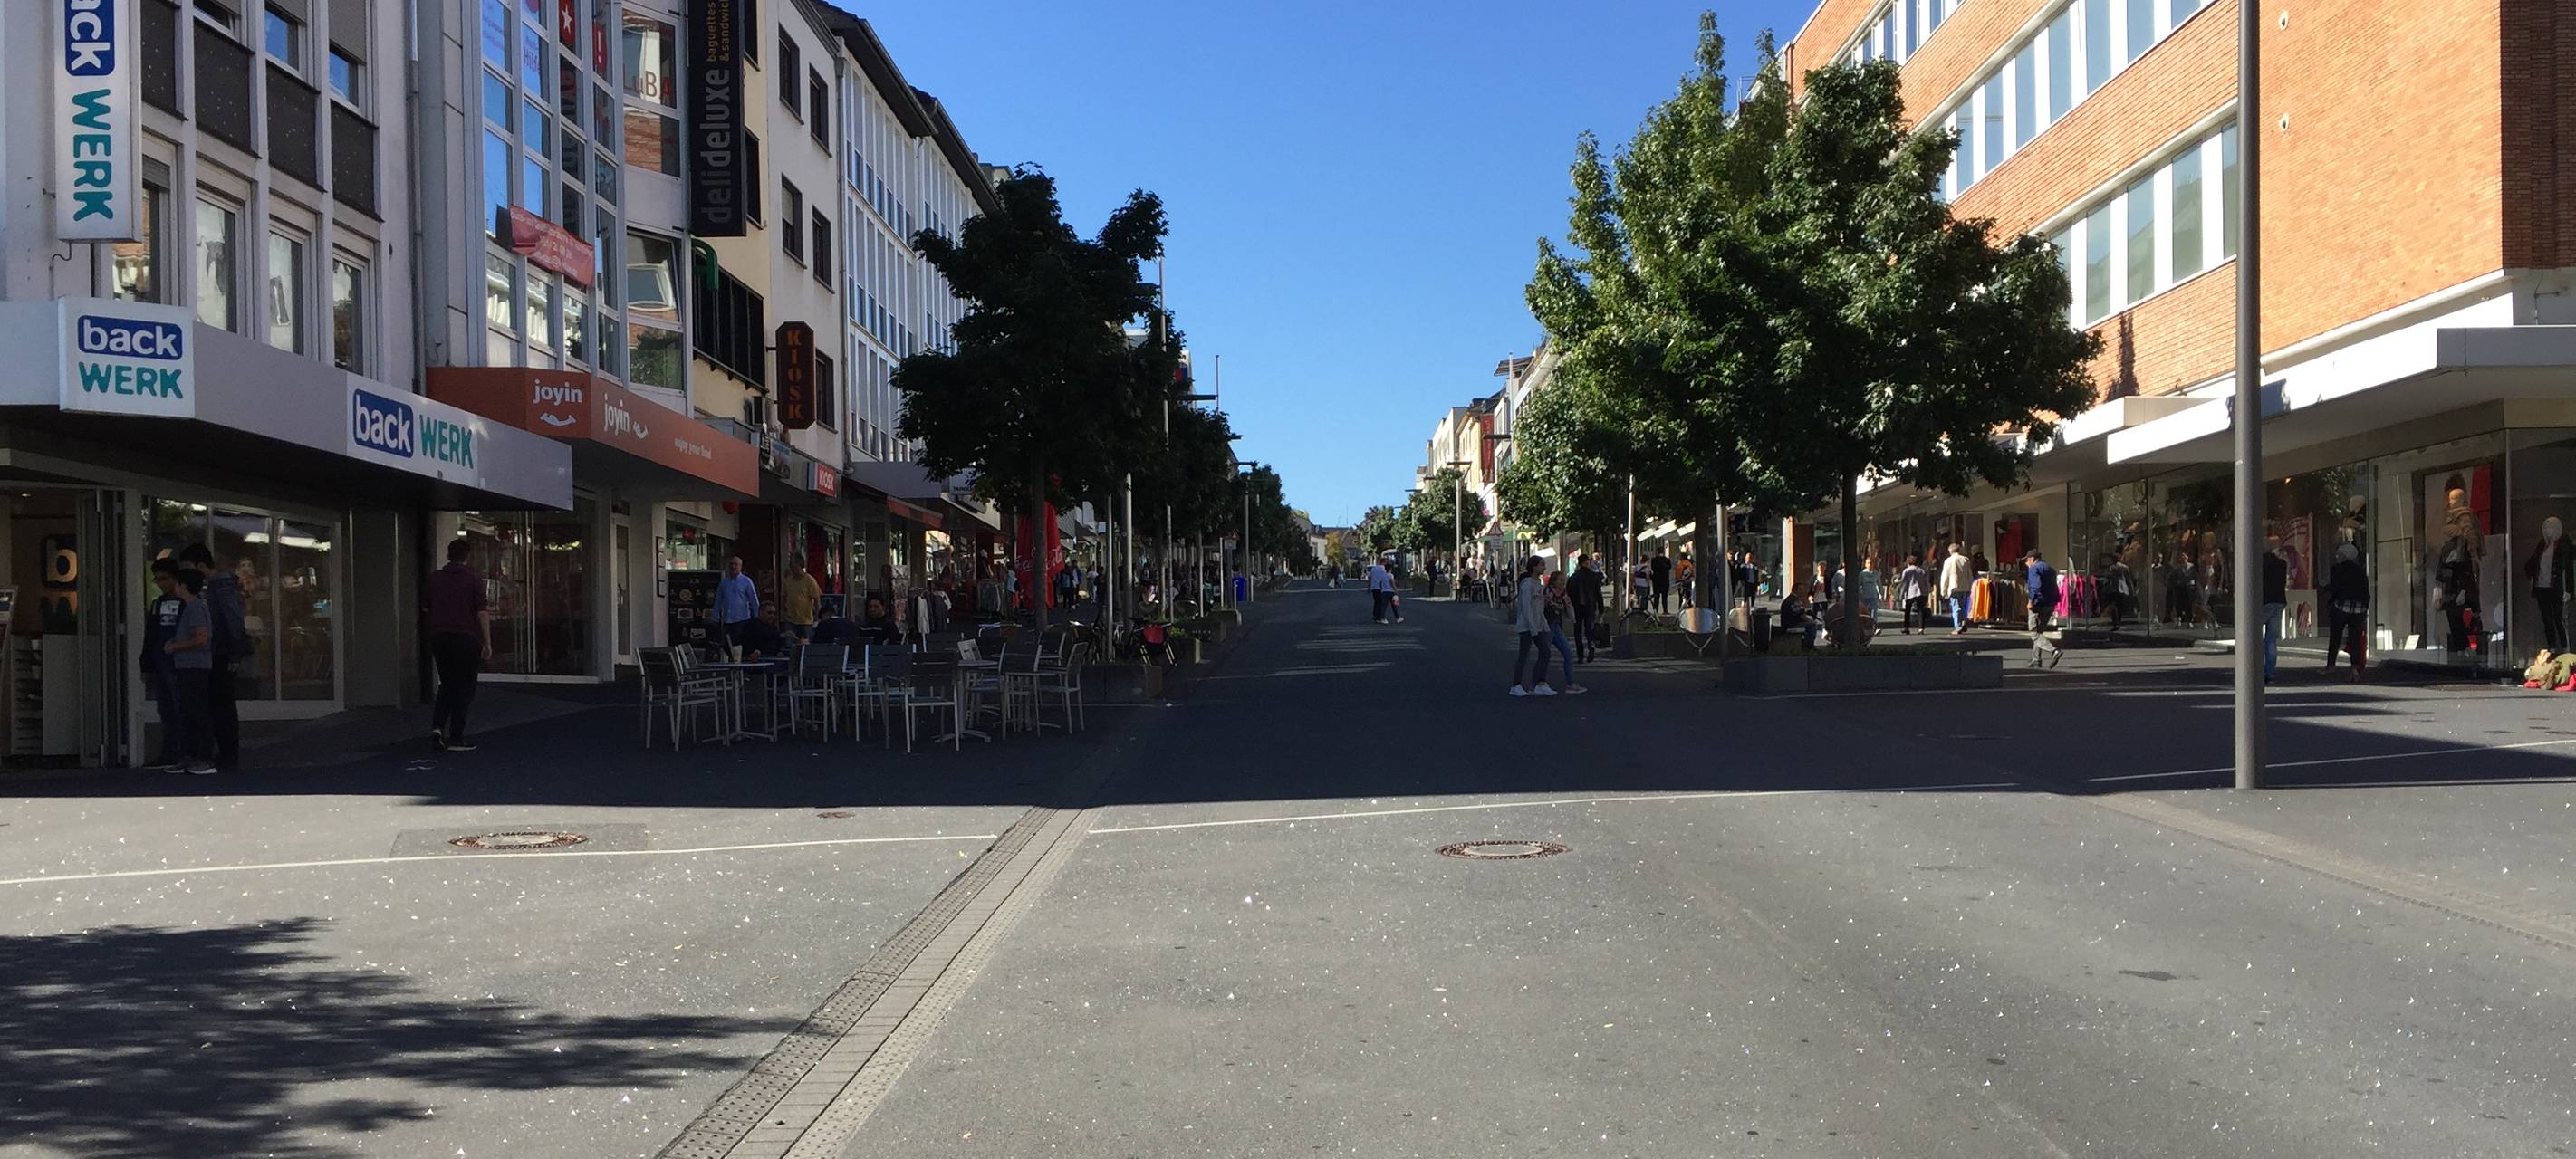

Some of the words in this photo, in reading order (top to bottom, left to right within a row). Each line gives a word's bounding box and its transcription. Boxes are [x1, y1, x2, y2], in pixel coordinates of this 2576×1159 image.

[706, 1, 719, 62] baguettes
[718, 0, 730, 62] &sandwic
[72, 89, 114, 221] WERK
[83, 319, 178, 357] back
[79, 361, 183, 399] WERK
[533, 378, 583, 406] joyin
[786, 330, 803, 420] KIOSK
[356, 394, 412, 453] back
[419, 414, 474, 469] WERK
[604, 393, 630, 435] joyin
[818, 469, 834, 491] KIOSK
